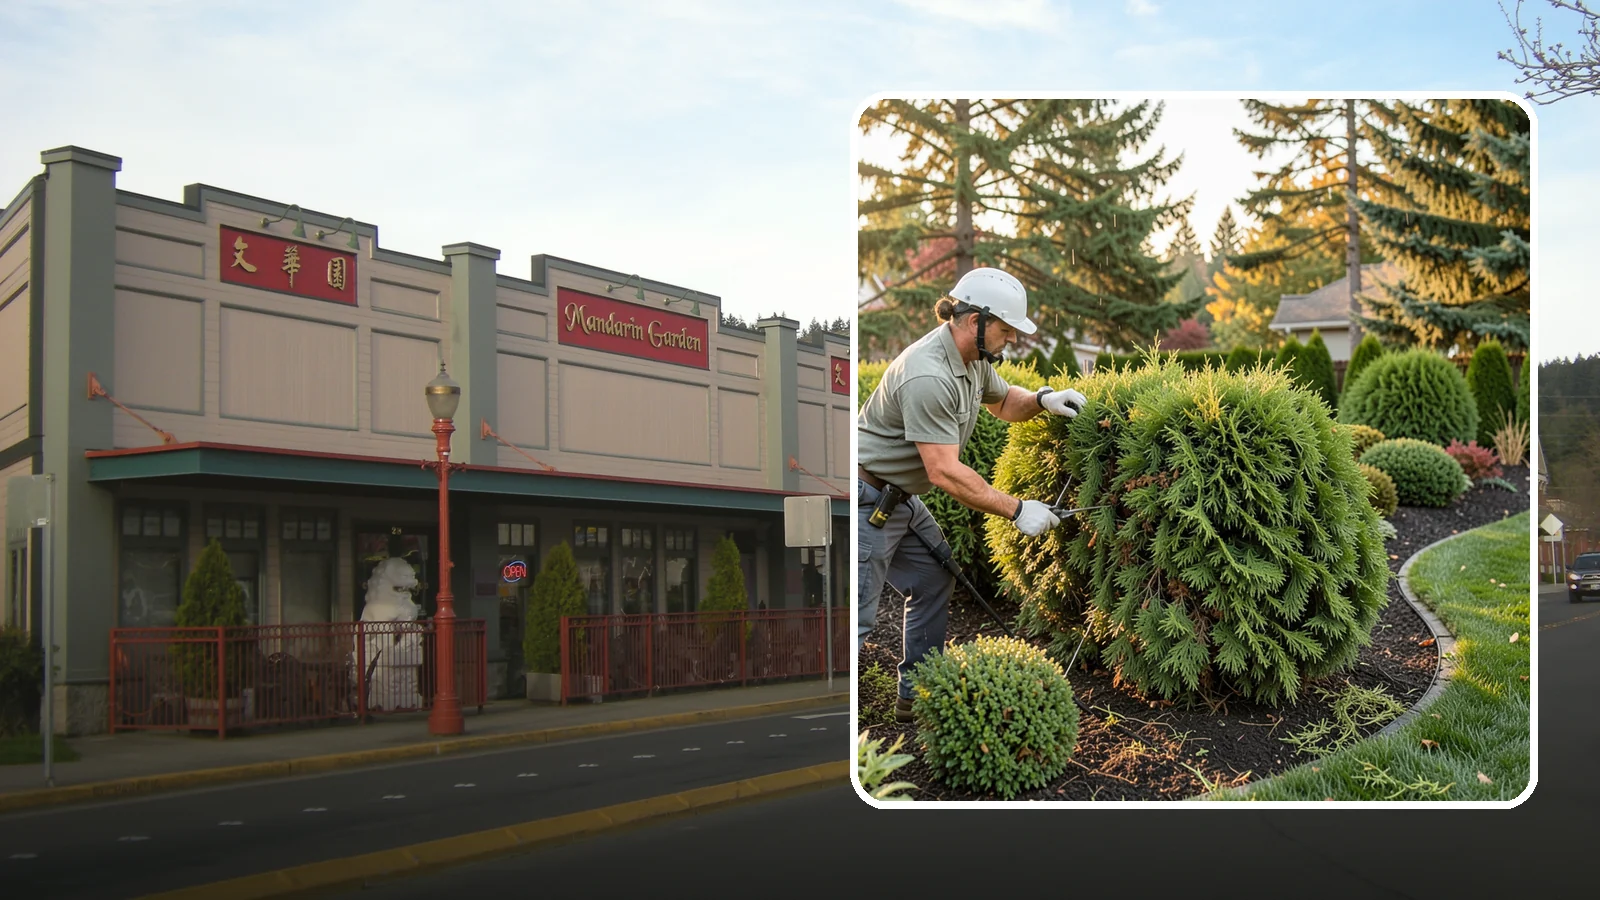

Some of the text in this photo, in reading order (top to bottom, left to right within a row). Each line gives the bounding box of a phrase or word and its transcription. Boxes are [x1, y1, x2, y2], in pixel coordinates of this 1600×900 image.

[230, 235, 346, 291] 文華園
[564, 302, 702, 352] Mandarin Garden
[503, 565, 527, 578] OPEN
